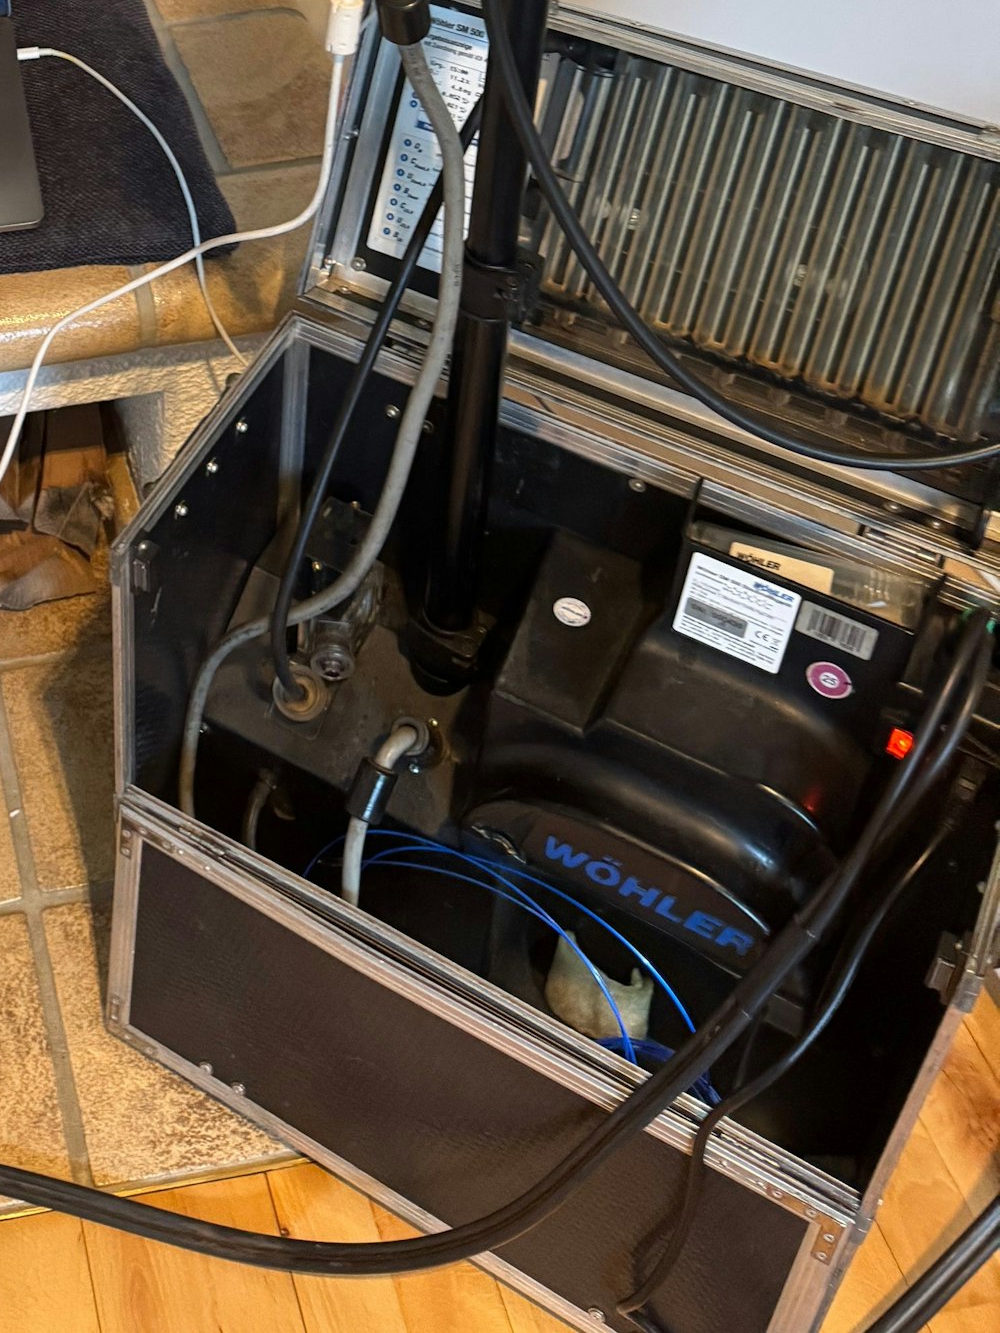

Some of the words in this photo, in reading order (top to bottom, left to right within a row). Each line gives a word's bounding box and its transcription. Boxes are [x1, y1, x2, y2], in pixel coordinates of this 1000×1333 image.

[456, 24, 470, 34] SM
[737, 552, 781, 570] WÖHLER
[753, 581, 795, 602] WÖHLER
[822, 674, 838, 686] 25
[544, 834, 755, 957] WÖHLER
